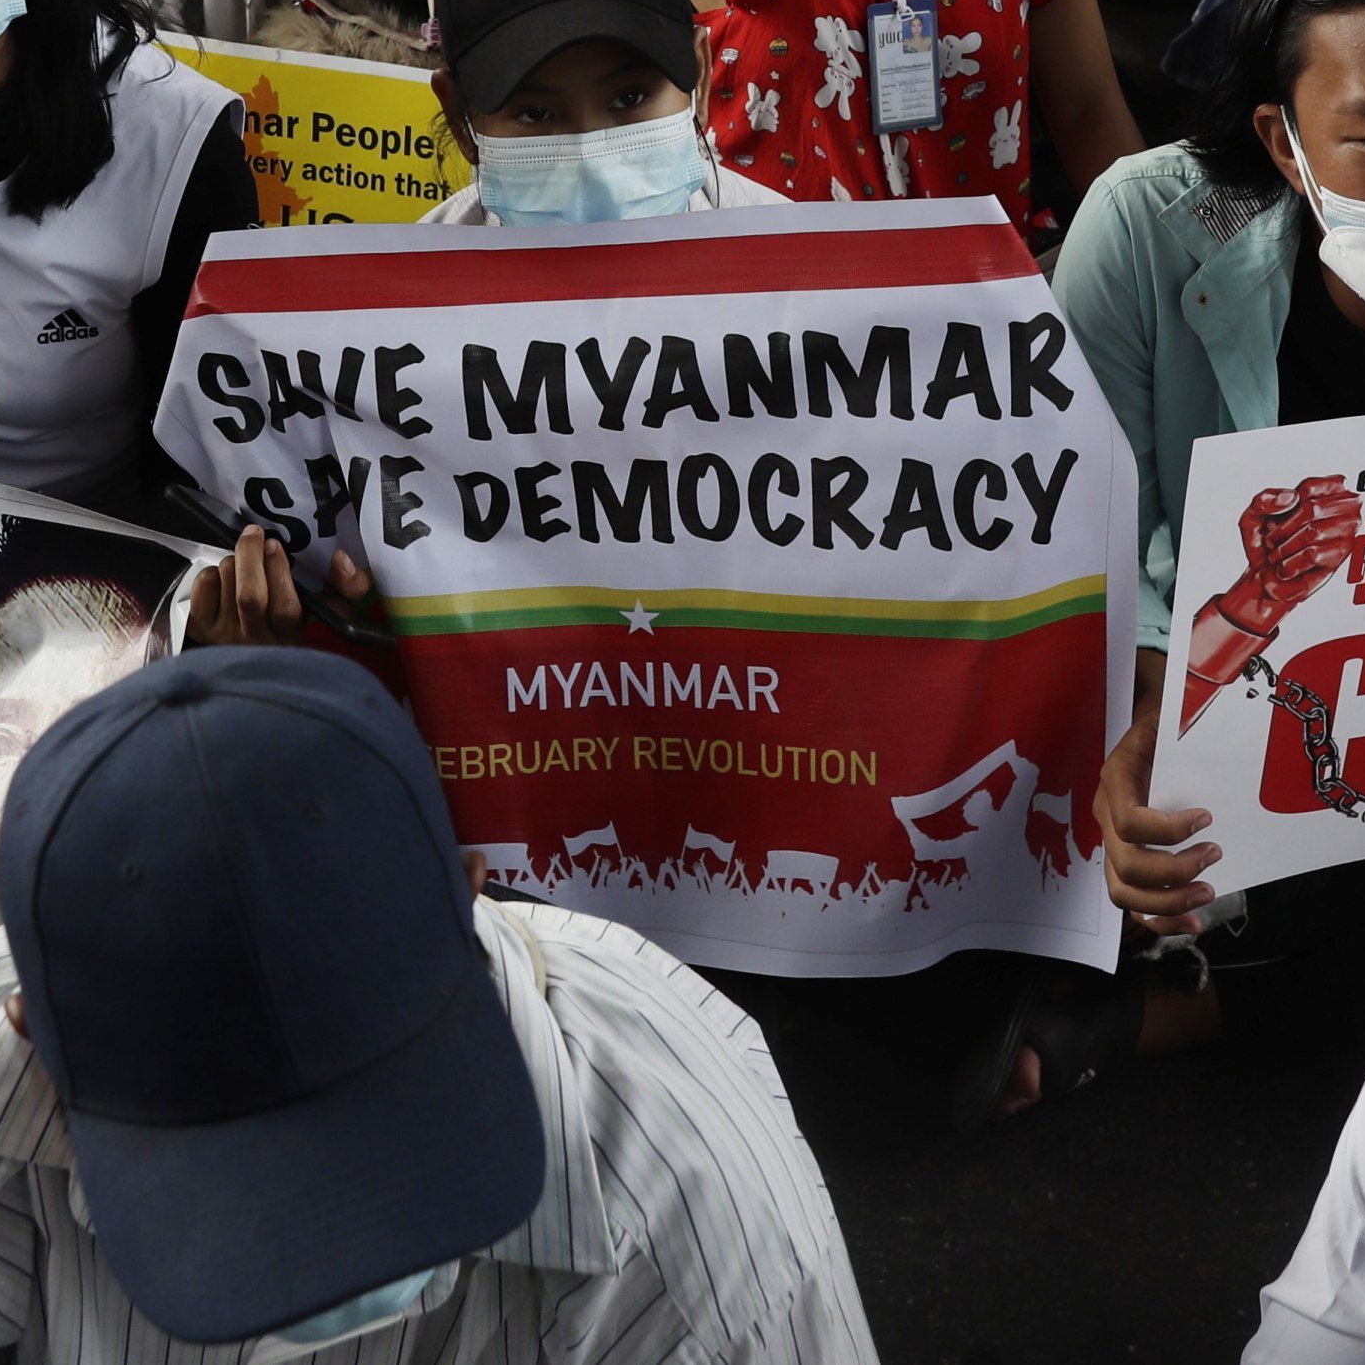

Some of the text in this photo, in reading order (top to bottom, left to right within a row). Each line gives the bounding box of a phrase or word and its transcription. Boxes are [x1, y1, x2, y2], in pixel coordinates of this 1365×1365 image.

[301, 162, 452, 203] action that
[37, 325, 99, 345] adidas
[196, 311, 1075, 447] SAVE MYANMAR
[453, 447, 1080, 553] DEMOCRACY
[506, 660, 781, 715] MYANMAR
[429, 737, 878, 788] EBRUARY REVOLUTION
